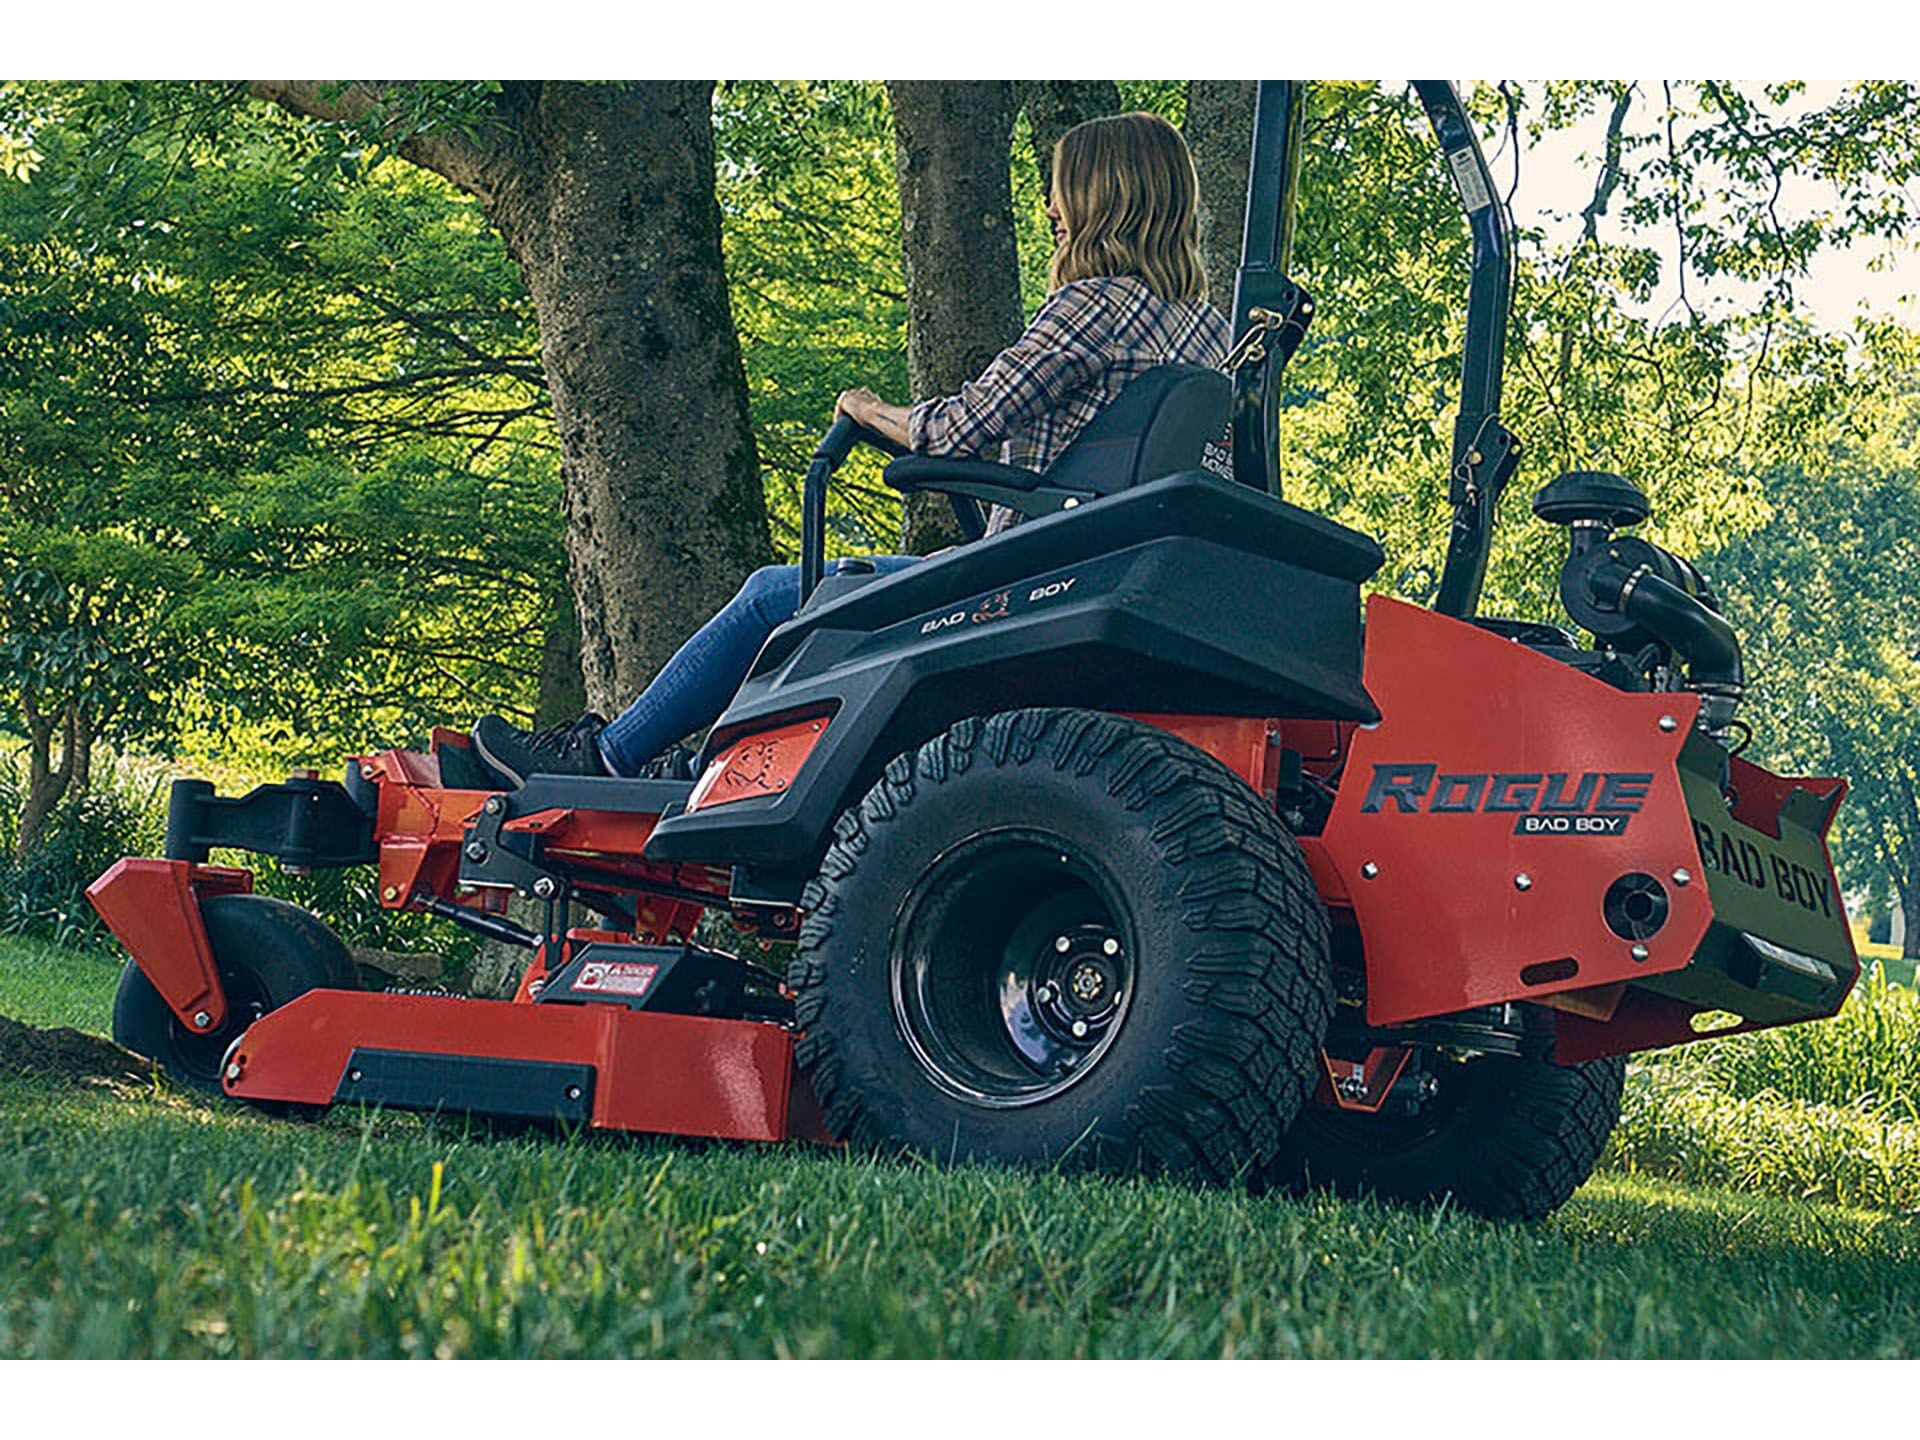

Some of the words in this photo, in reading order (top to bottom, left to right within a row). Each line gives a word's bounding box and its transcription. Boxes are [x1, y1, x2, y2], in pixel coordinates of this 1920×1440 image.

[920, 611, 966, 634] BAD
[1029, 577, 1076, 601] BOY
[1525, 817, 1569, 832] BAD
[1575, 817, 1620, 832] BOY
[1692, 818, 1765, 889] BAD
[1770, 853, 1831, 918] BOY
